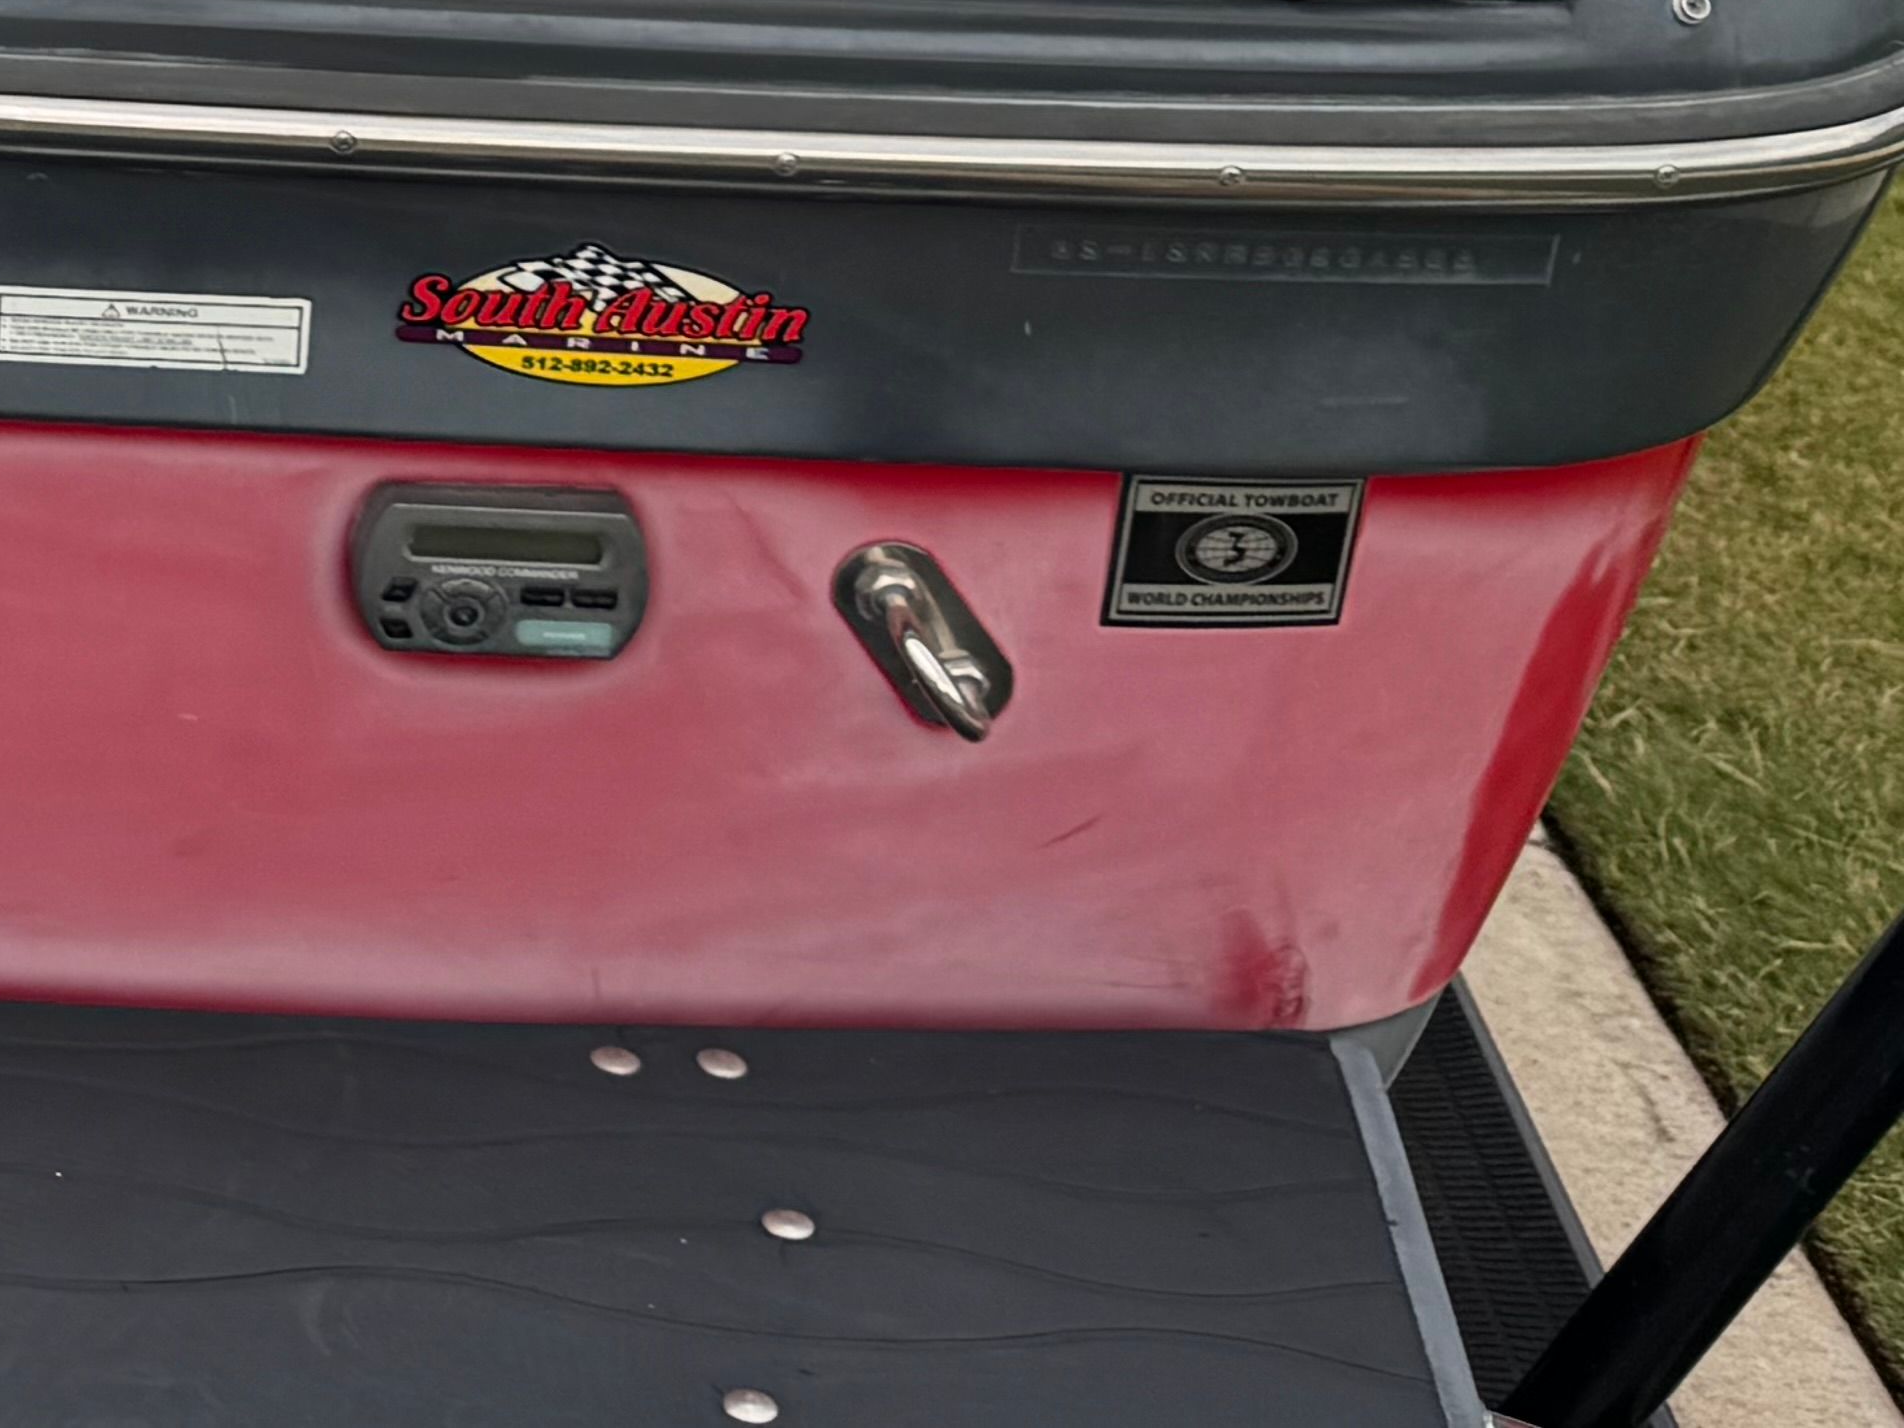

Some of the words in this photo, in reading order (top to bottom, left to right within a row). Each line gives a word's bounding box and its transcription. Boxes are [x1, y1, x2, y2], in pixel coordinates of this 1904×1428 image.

[125, 305, 199, 319] WARNING
[401, 274, 585, 328] South
[594, 286, 809, 342] Austin
[436, 329, 770, 361] MARINE
[521, 355, 674, 378] 512-892-2432
[1150, 492, 1237, 508] OFFICIAL
[1244, 493, 1339, 508] TOWBOAT
[1128, 591, 1191, 606] WORLD
[1192, 591, 1325, 607] CHAMPIONSHIPS
